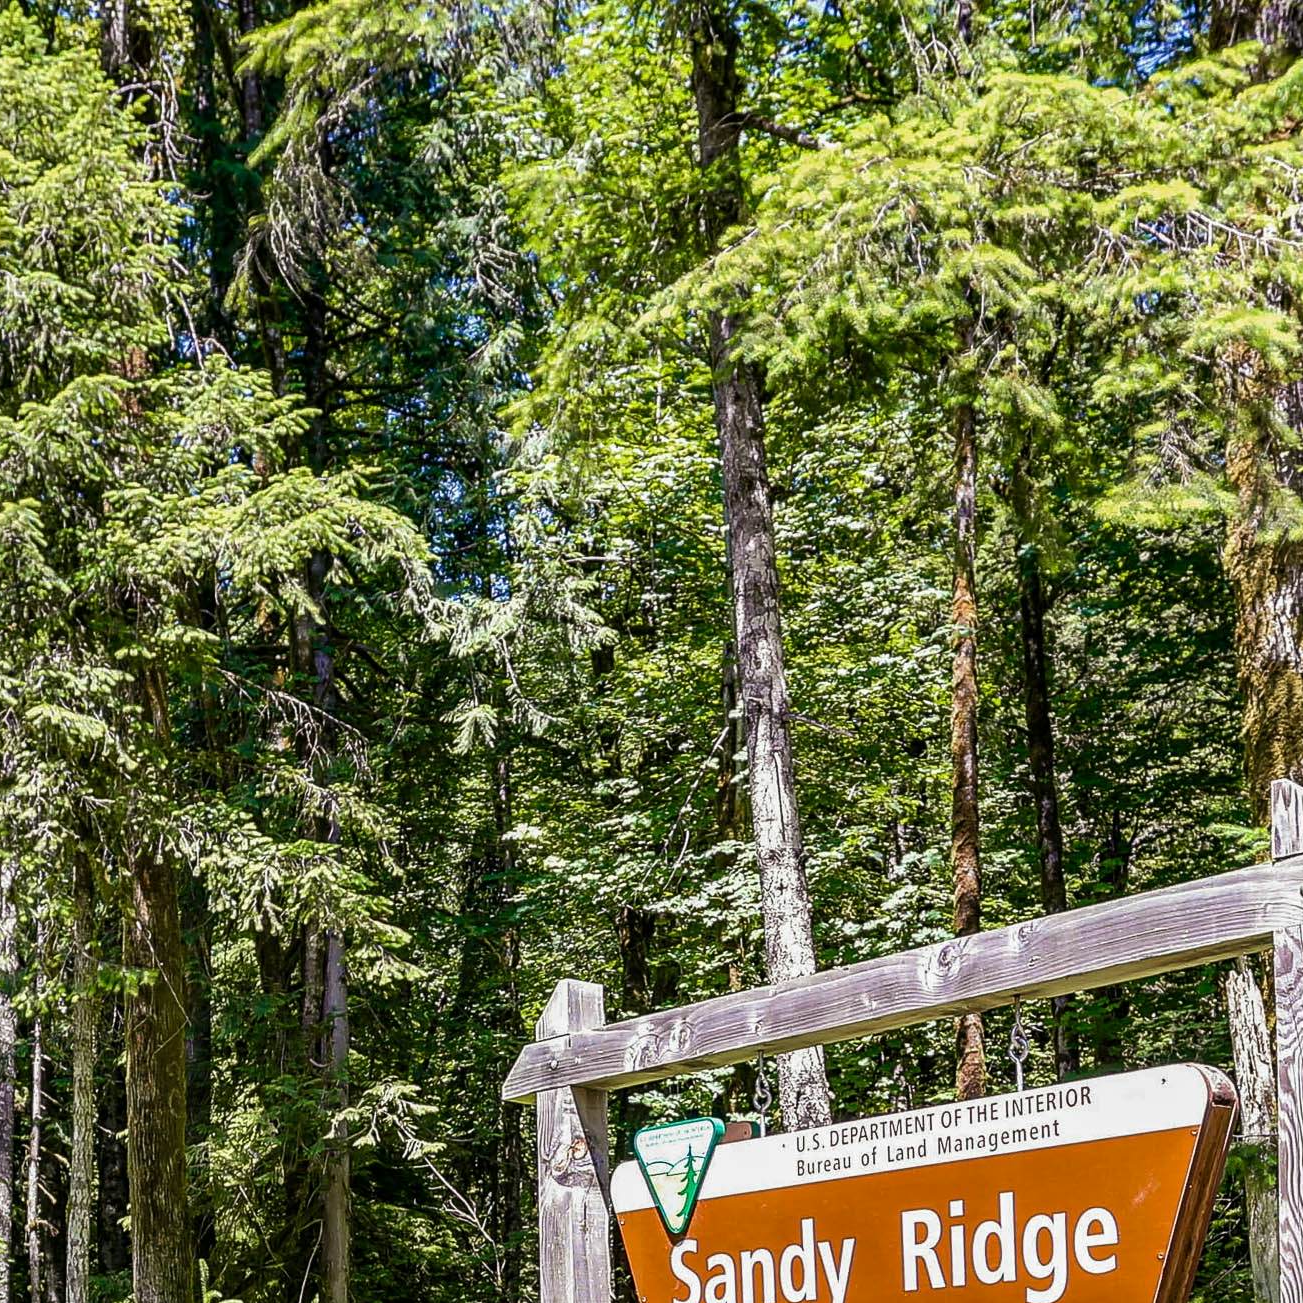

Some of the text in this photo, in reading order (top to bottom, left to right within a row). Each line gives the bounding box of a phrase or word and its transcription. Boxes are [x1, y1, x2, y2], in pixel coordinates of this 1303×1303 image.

[796, 1085, 1092, 1153] U.S. DEPARTMENT OF THE INTERIOR
[797, 1119, 1060, 1177] Bureau of Land Management
